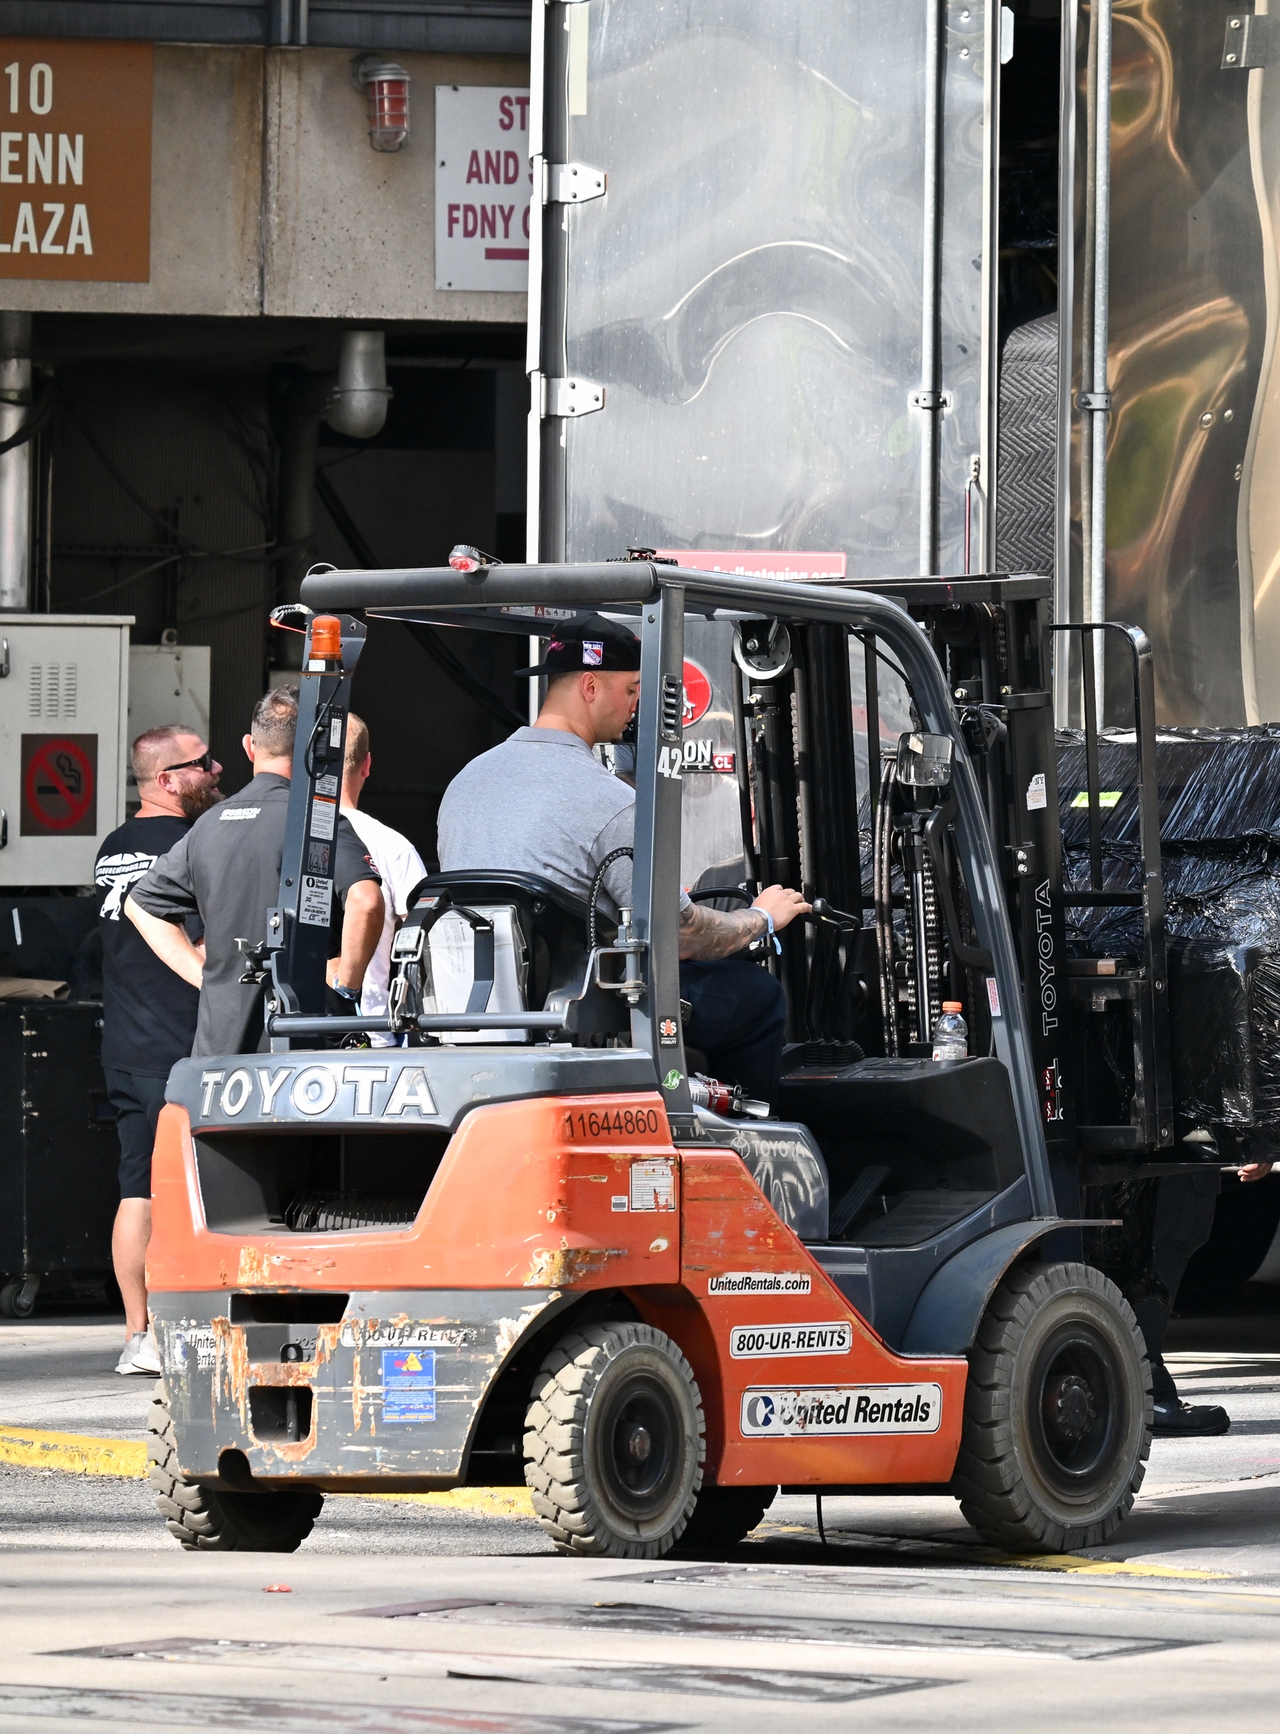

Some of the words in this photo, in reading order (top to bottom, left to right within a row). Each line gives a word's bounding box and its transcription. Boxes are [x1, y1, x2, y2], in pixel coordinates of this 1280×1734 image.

[4, 62, 53, 115] 10
[465, 149, 519, 184] AND
[447, 203, 515, 239] FDNY
[657, 746, 683, 780] 42
[714, 756, 732, 769] CL
[1035, 878, 1058, 1036] TOYOTA
[660, 1019, 677, 1036] SAS
[202, 1066, 441, 1118] TOYOTA
[565, 1109, 658, 1138] 11644860
[752, 1140, 806, 1158] TOYOTA
[709, 1276, 810, 1291] UnitedRentals.com
[737, 1330, 846, 1351] 800-UR-RENTS
[854, 1395, 931, 1424] Rentals
